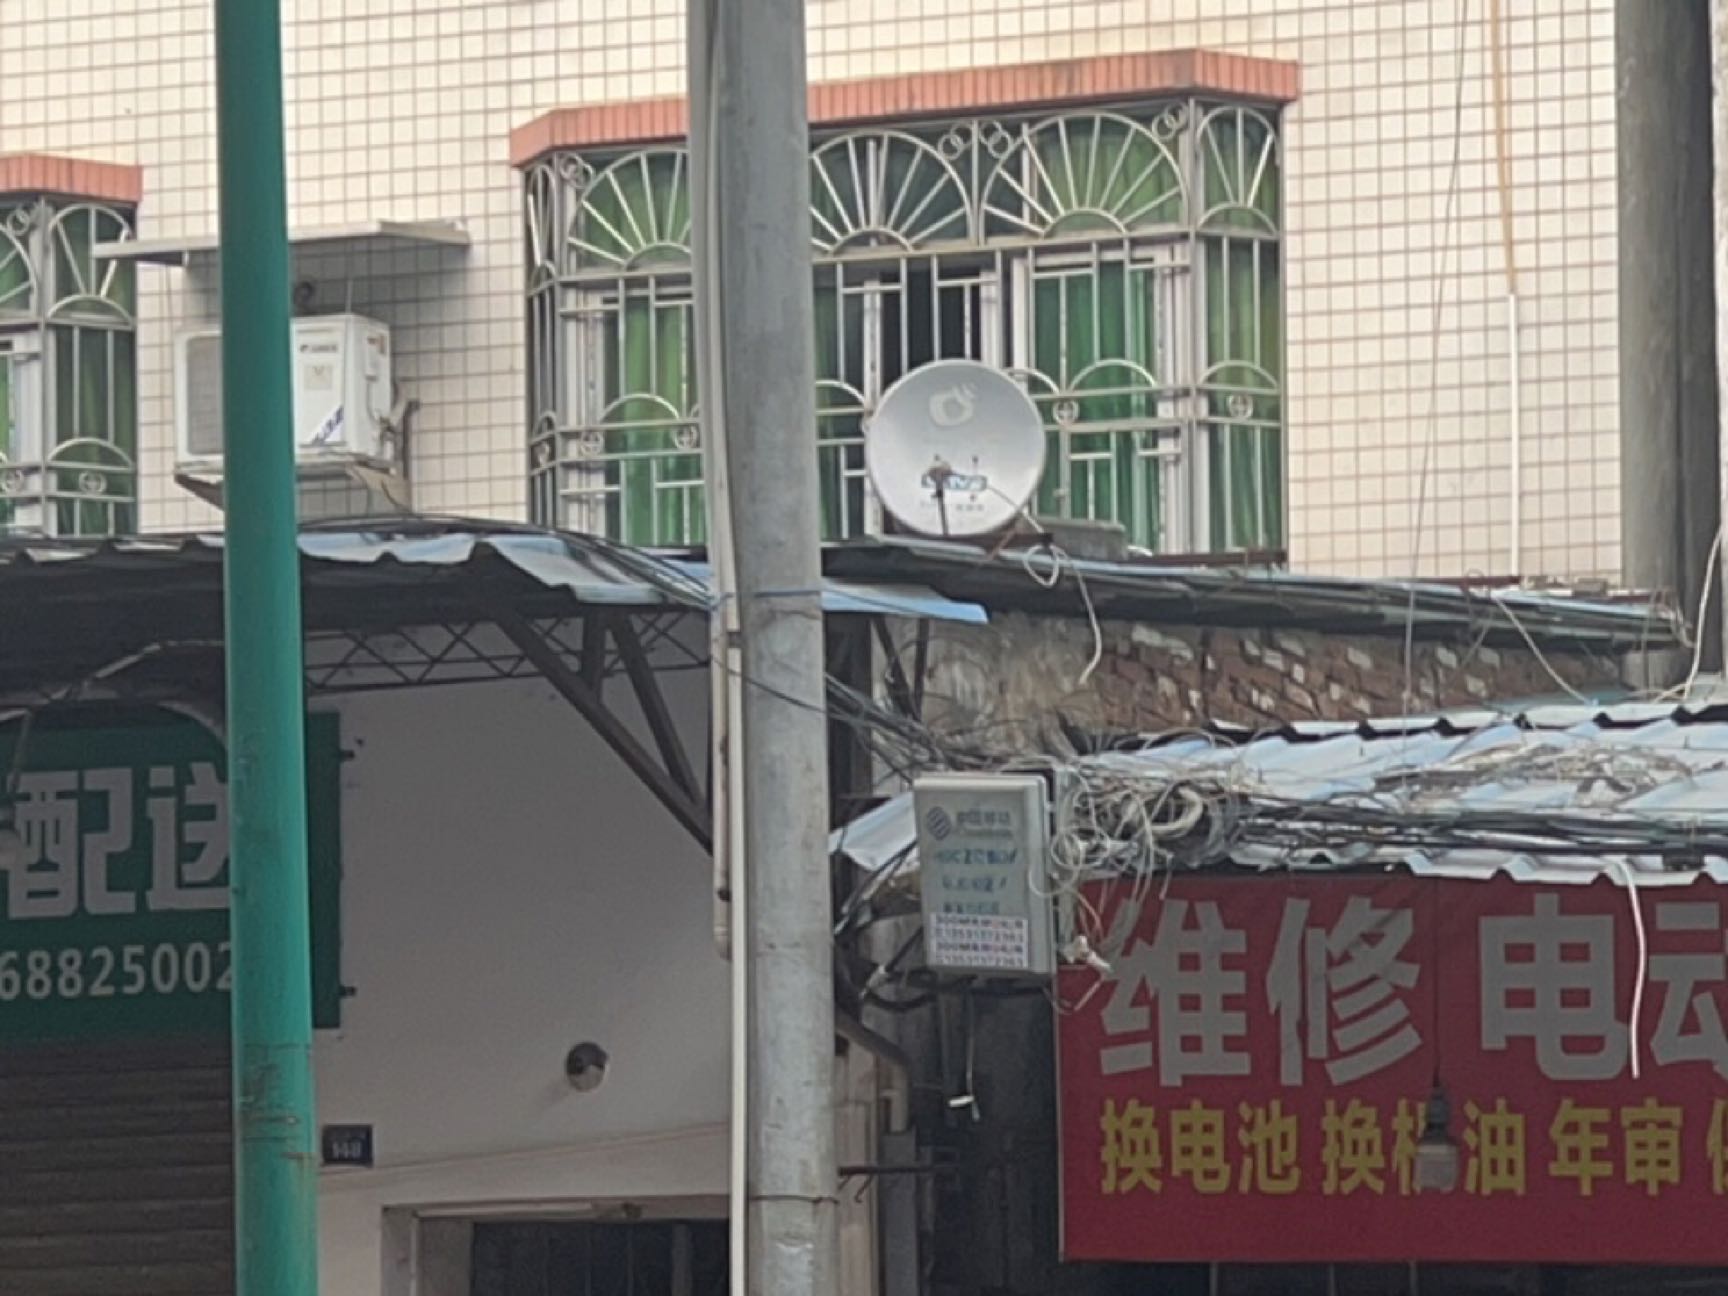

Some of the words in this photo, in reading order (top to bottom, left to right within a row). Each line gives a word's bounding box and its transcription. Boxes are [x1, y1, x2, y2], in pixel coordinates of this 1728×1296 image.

[6, 762, 230, 920] 配送
[1099, 895, 1422, 1087] 维修
[1099, 1097, 1302, 1195] 换电池
[1549, 1097, 1683, 1196] 年审
